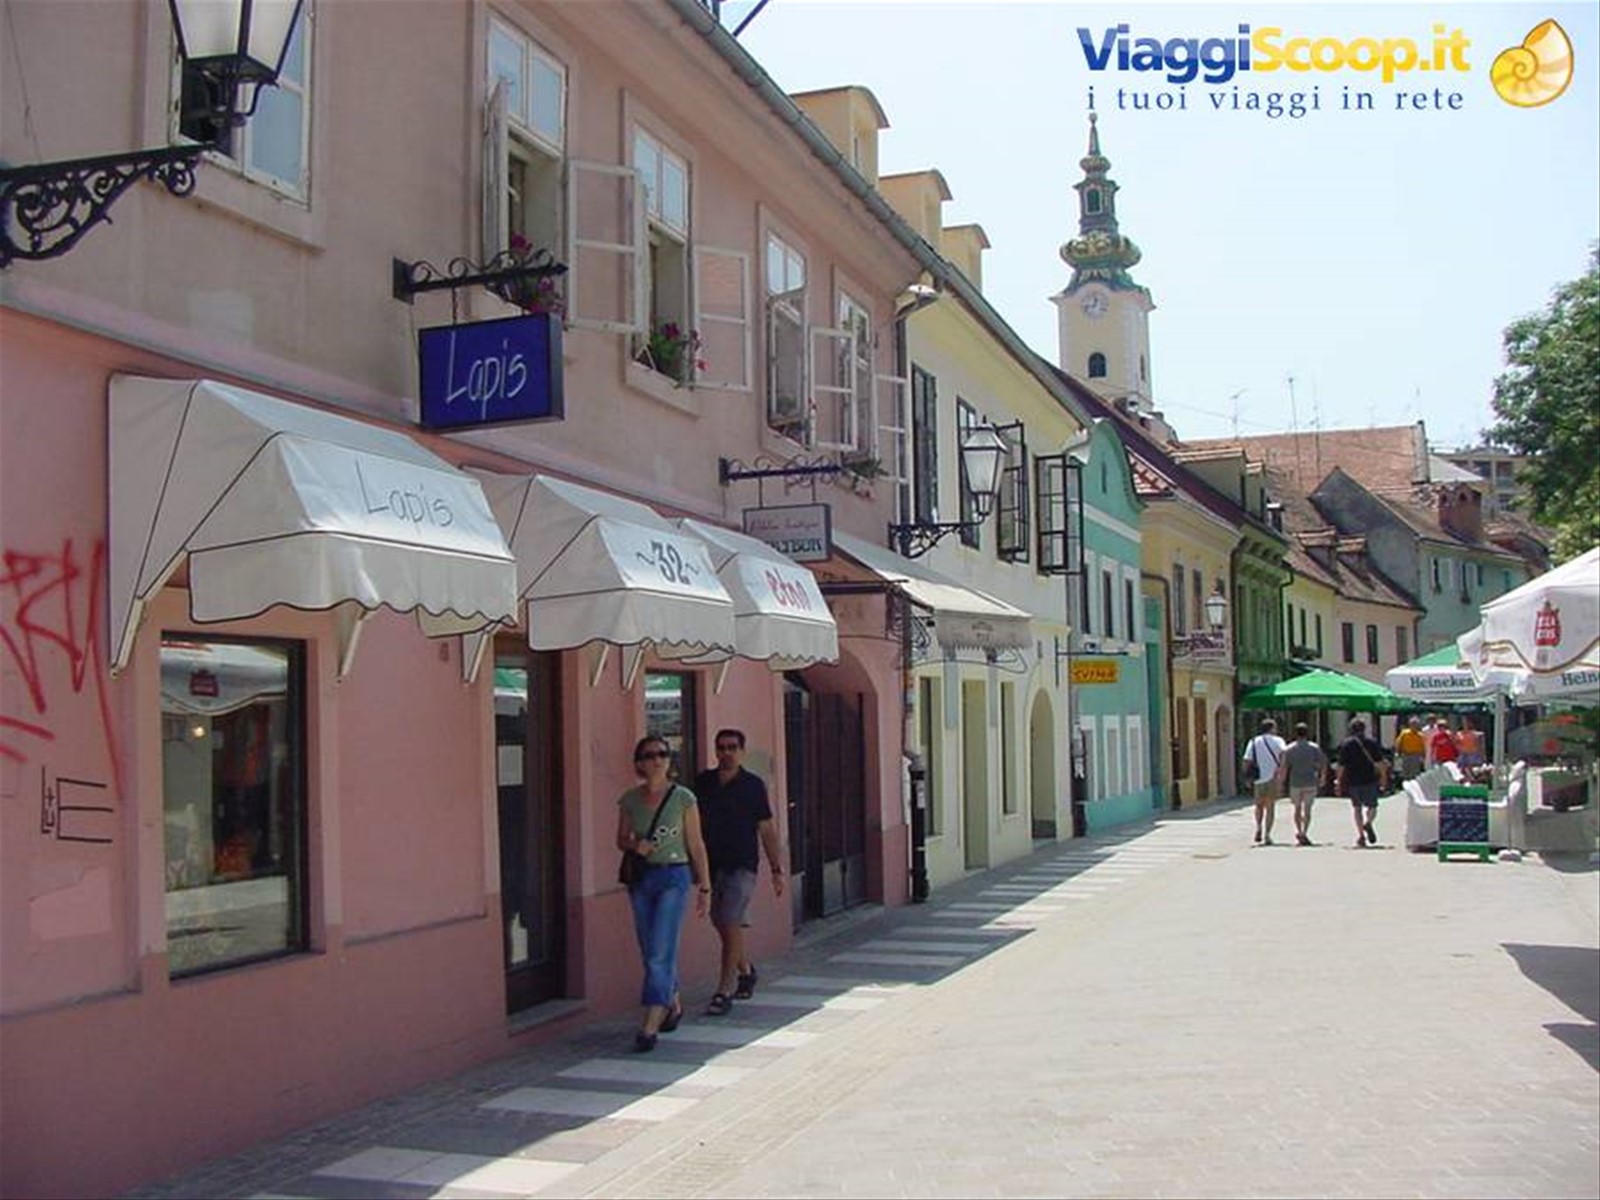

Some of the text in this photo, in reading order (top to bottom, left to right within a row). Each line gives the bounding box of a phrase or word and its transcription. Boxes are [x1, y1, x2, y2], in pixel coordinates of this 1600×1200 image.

[445, 330, 528, 421] Lapis
[354, 458, 455, 533] Lapis
[1409, 674, 1475, 689] Heineken
